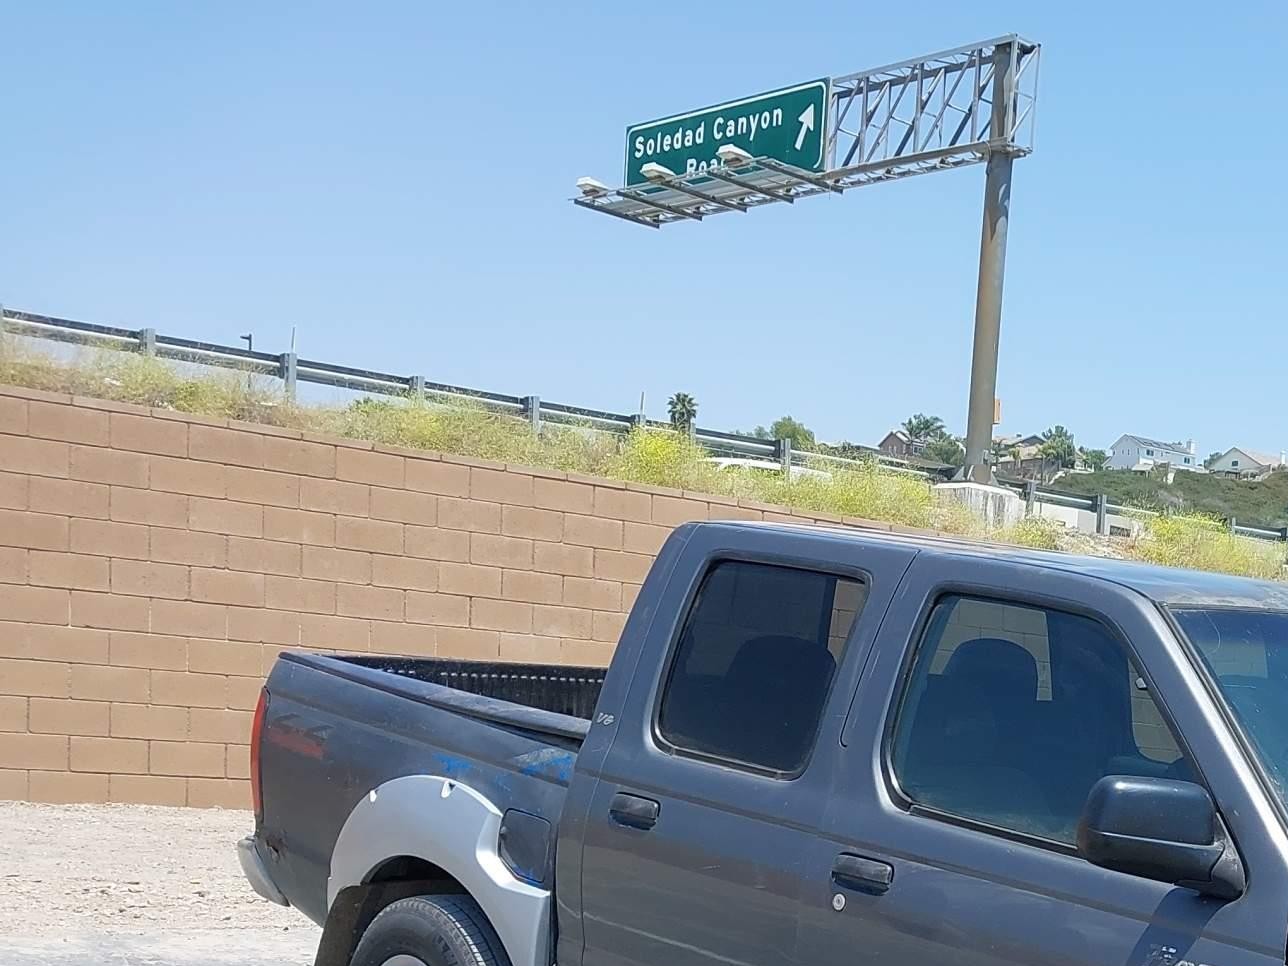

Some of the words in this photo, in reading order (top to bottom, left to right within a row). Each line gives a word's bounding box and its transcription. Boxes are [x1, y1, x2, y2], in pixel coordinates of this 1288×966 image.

[634, 121, 705, 158] Soledad
[713, 107, 783, 141] Canyon
[686, 158, 727, 177] Roa
